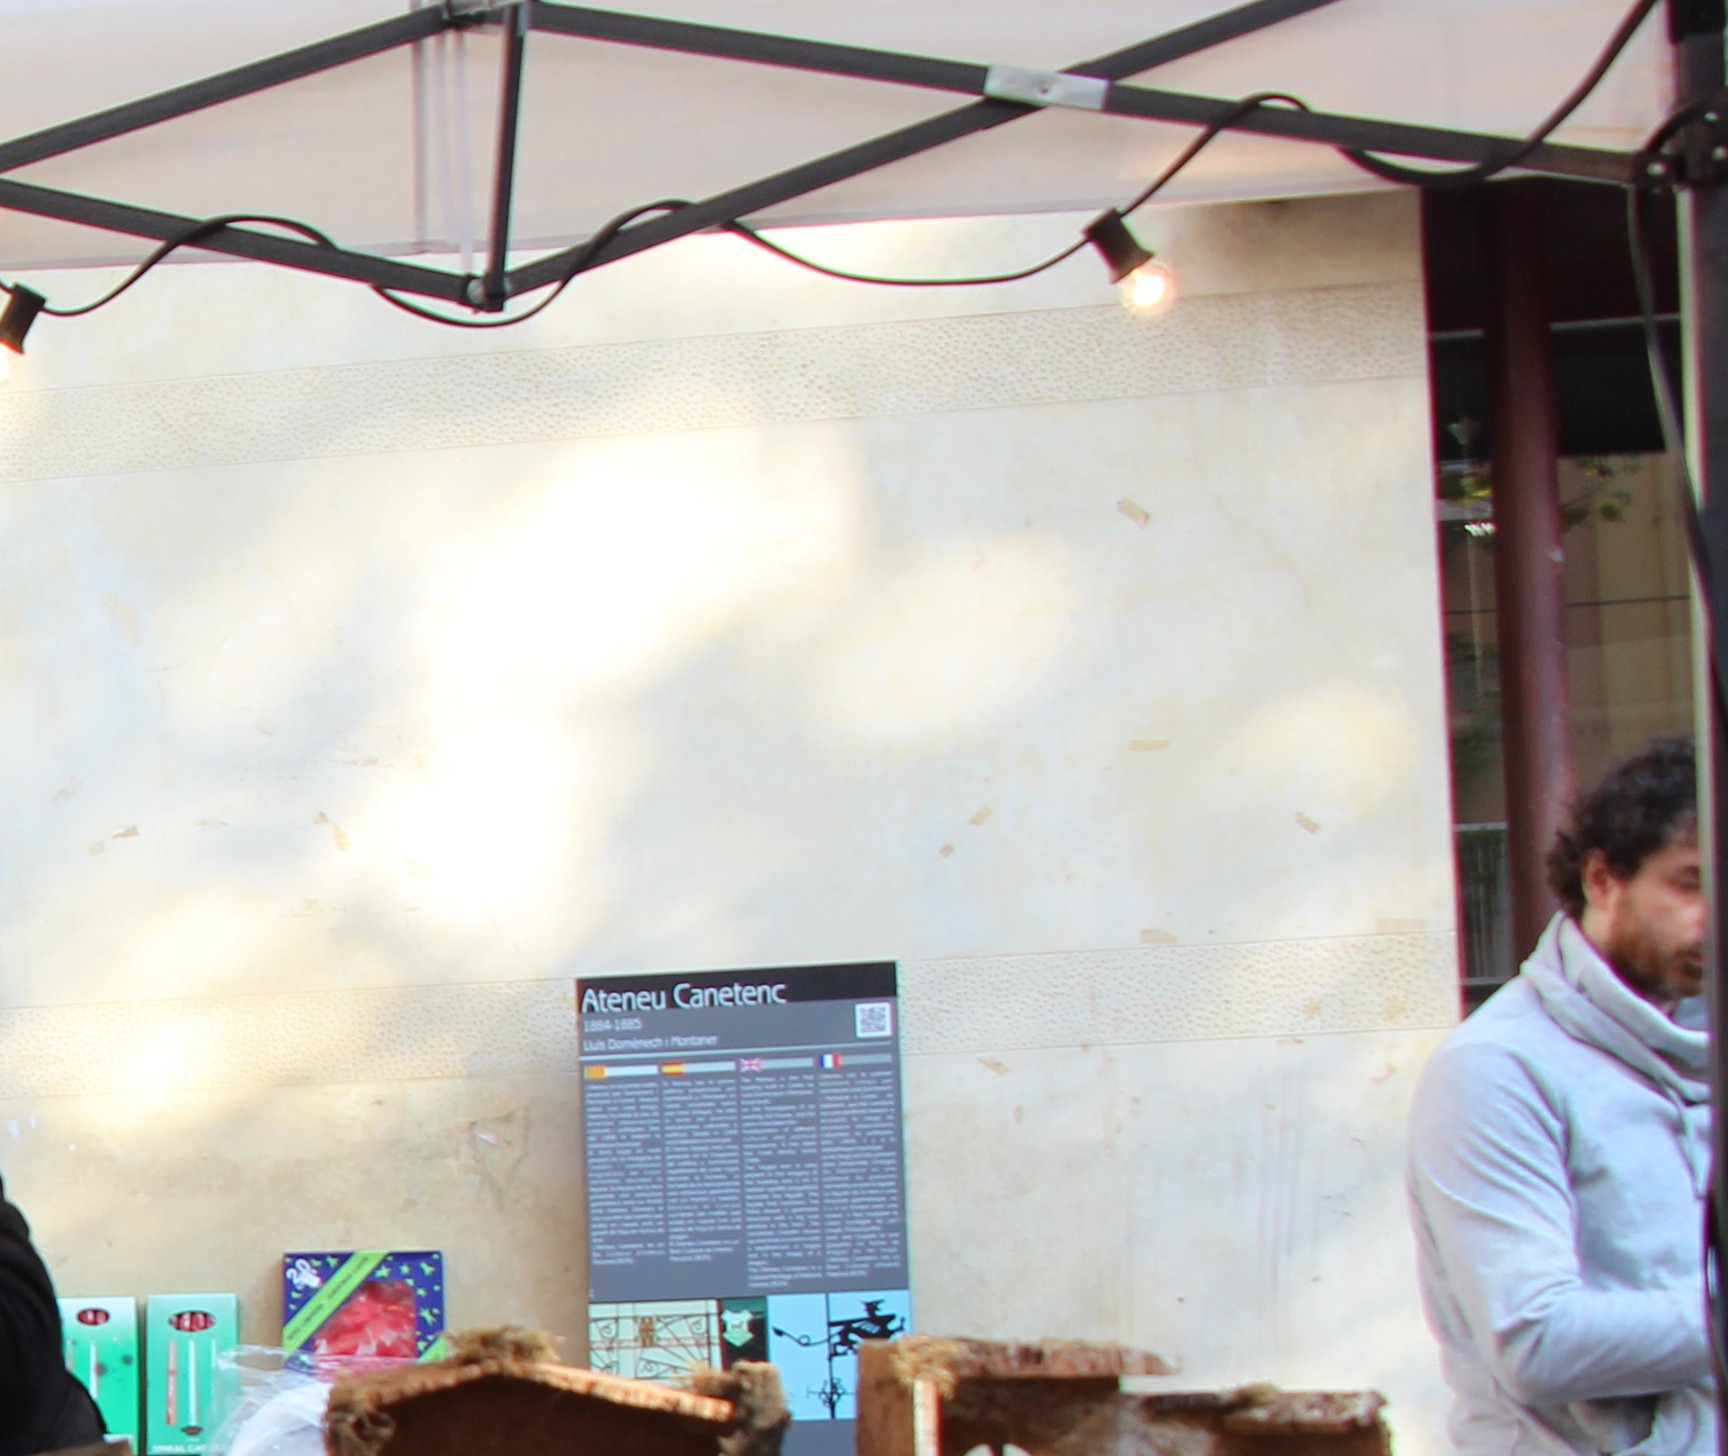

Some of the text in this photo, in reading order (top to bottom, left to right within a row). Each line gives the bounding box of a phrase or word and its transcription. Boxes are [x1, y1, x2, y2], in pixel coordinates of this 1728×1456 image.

[581, 981, 787, 1013] Ateneu Canetenc
[583, 1018, 643, 1033] 1884-1885
